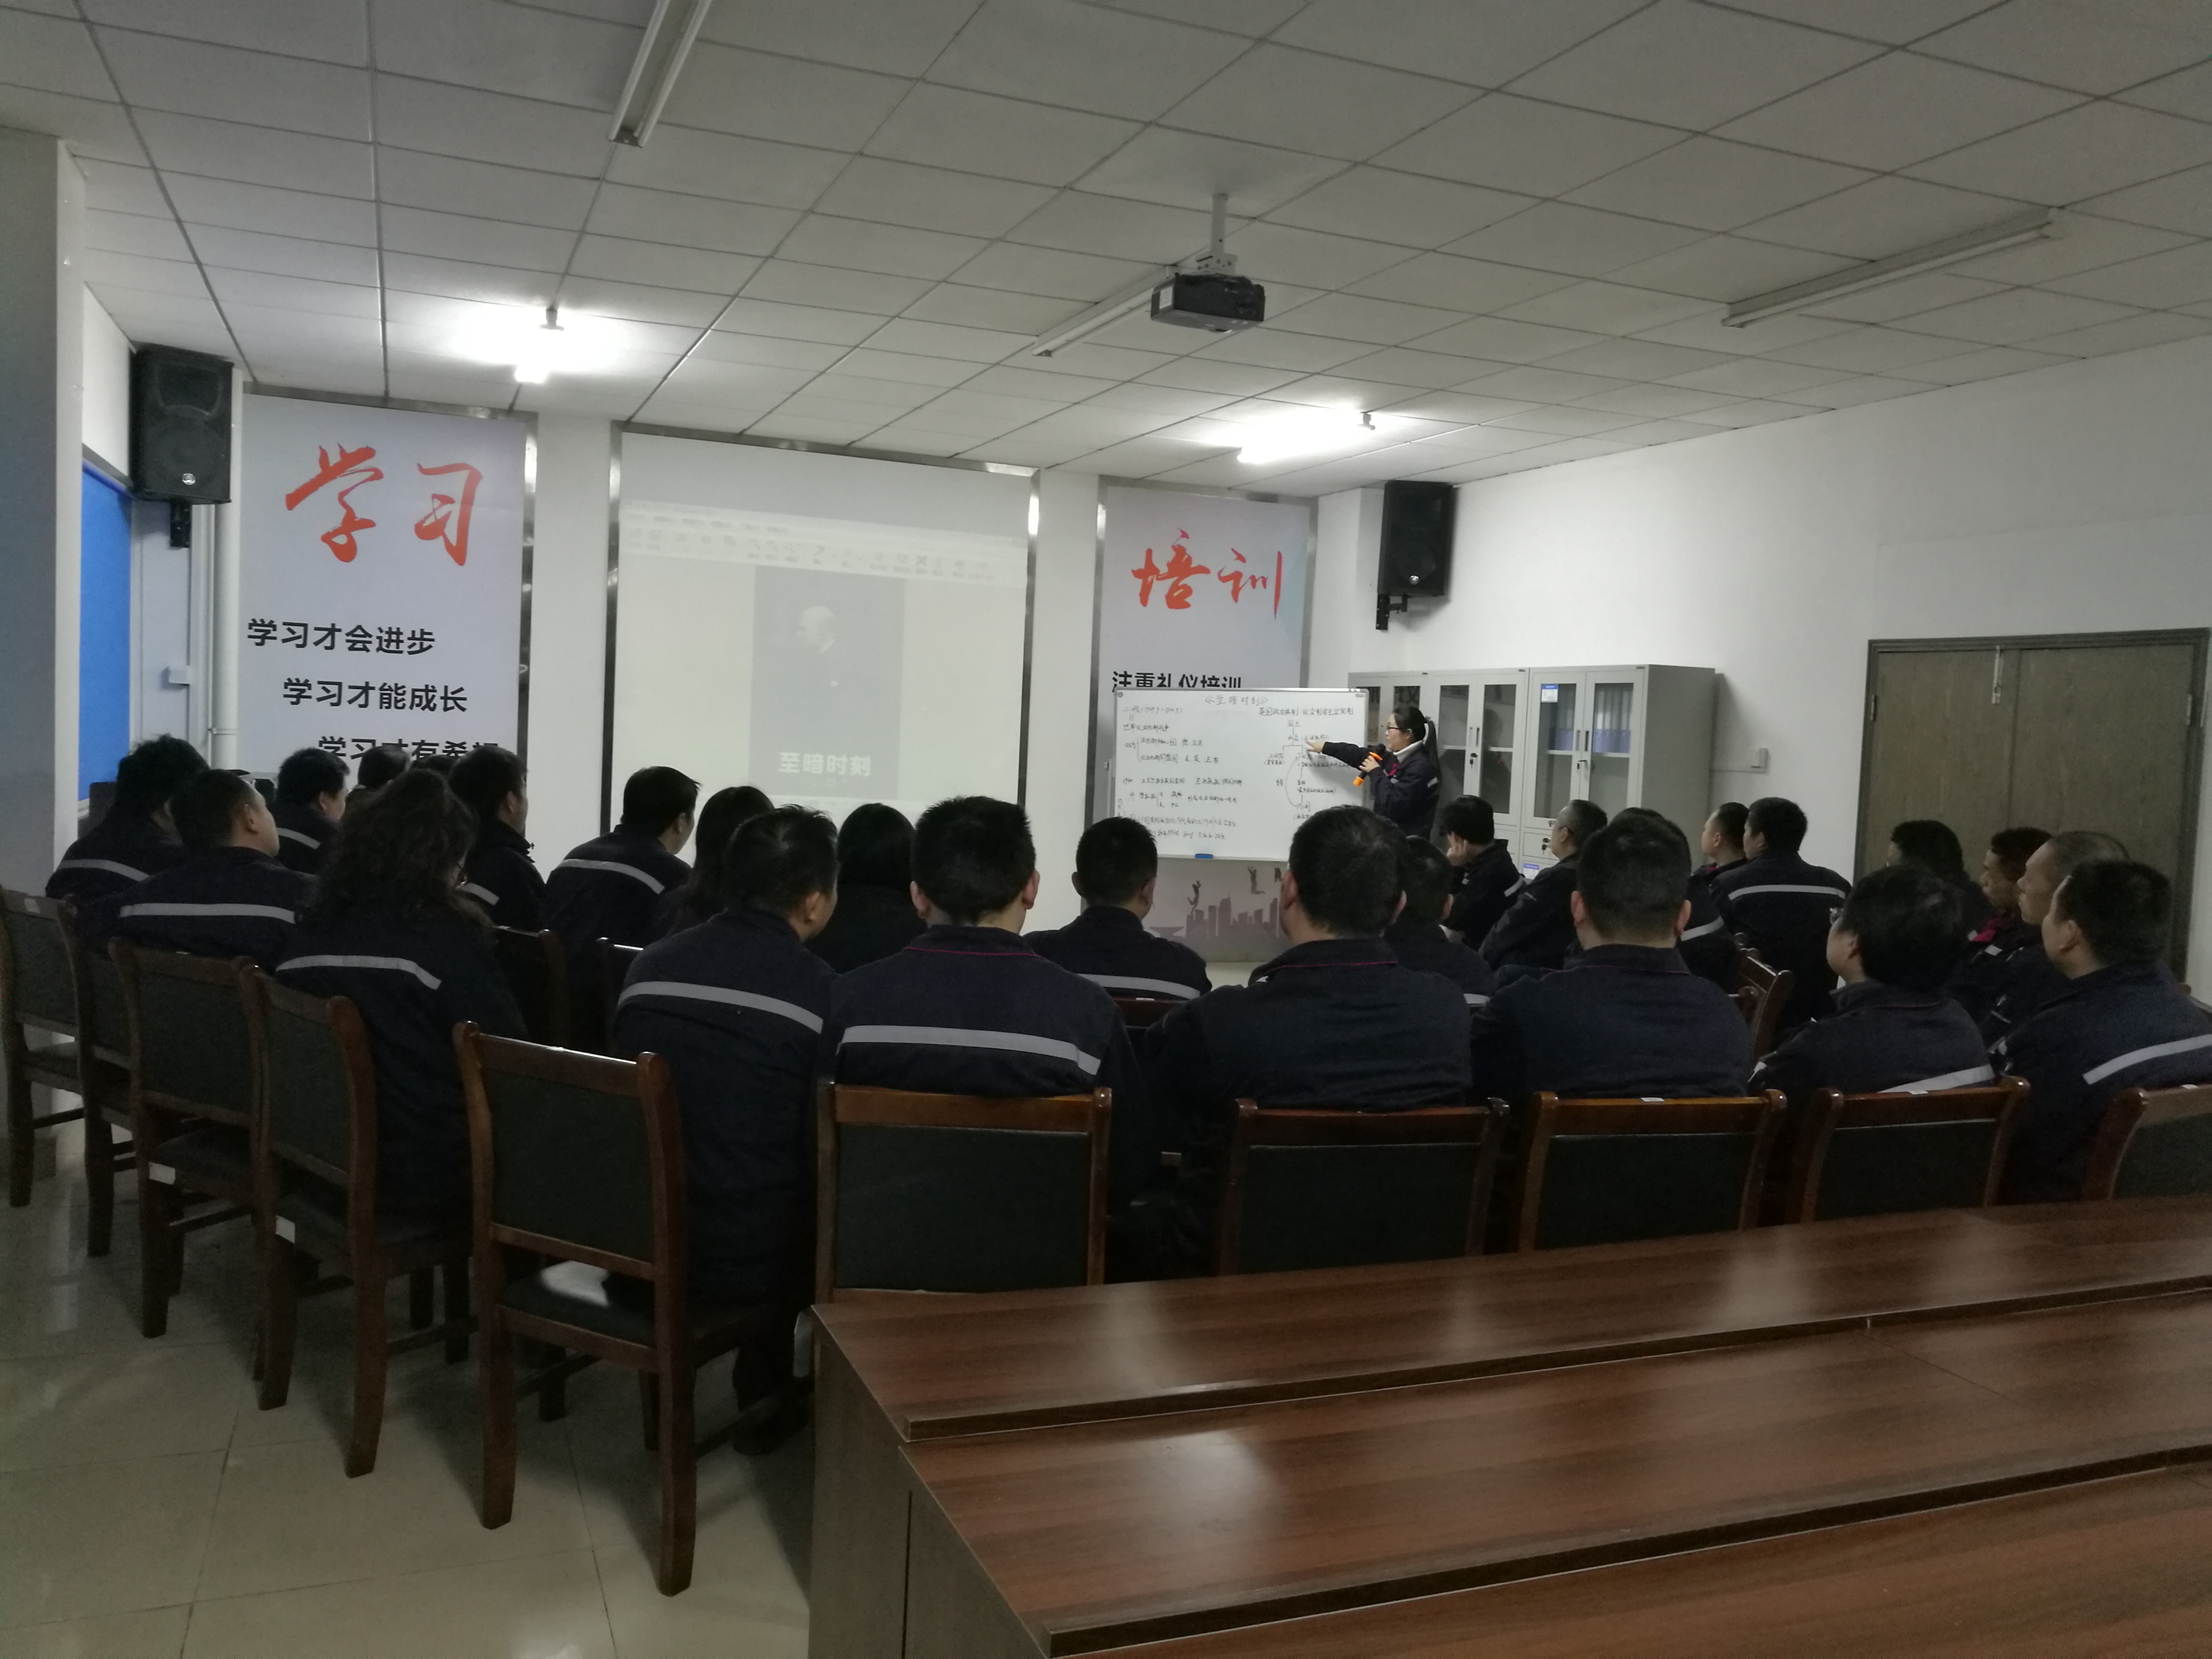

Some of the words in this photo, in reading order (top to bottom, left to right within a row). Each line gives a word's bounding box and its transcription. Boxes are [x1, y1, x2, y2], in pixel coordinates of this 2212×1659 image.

[285, 442, 483, 566] 学习
[1131, 528, 1283, 620] 培训
[246, 618, 436, 656] 学习才会进步
[283, 678, 468, 713] 学习才能成长
[778, 751, 871, 777] 至暗时刻
